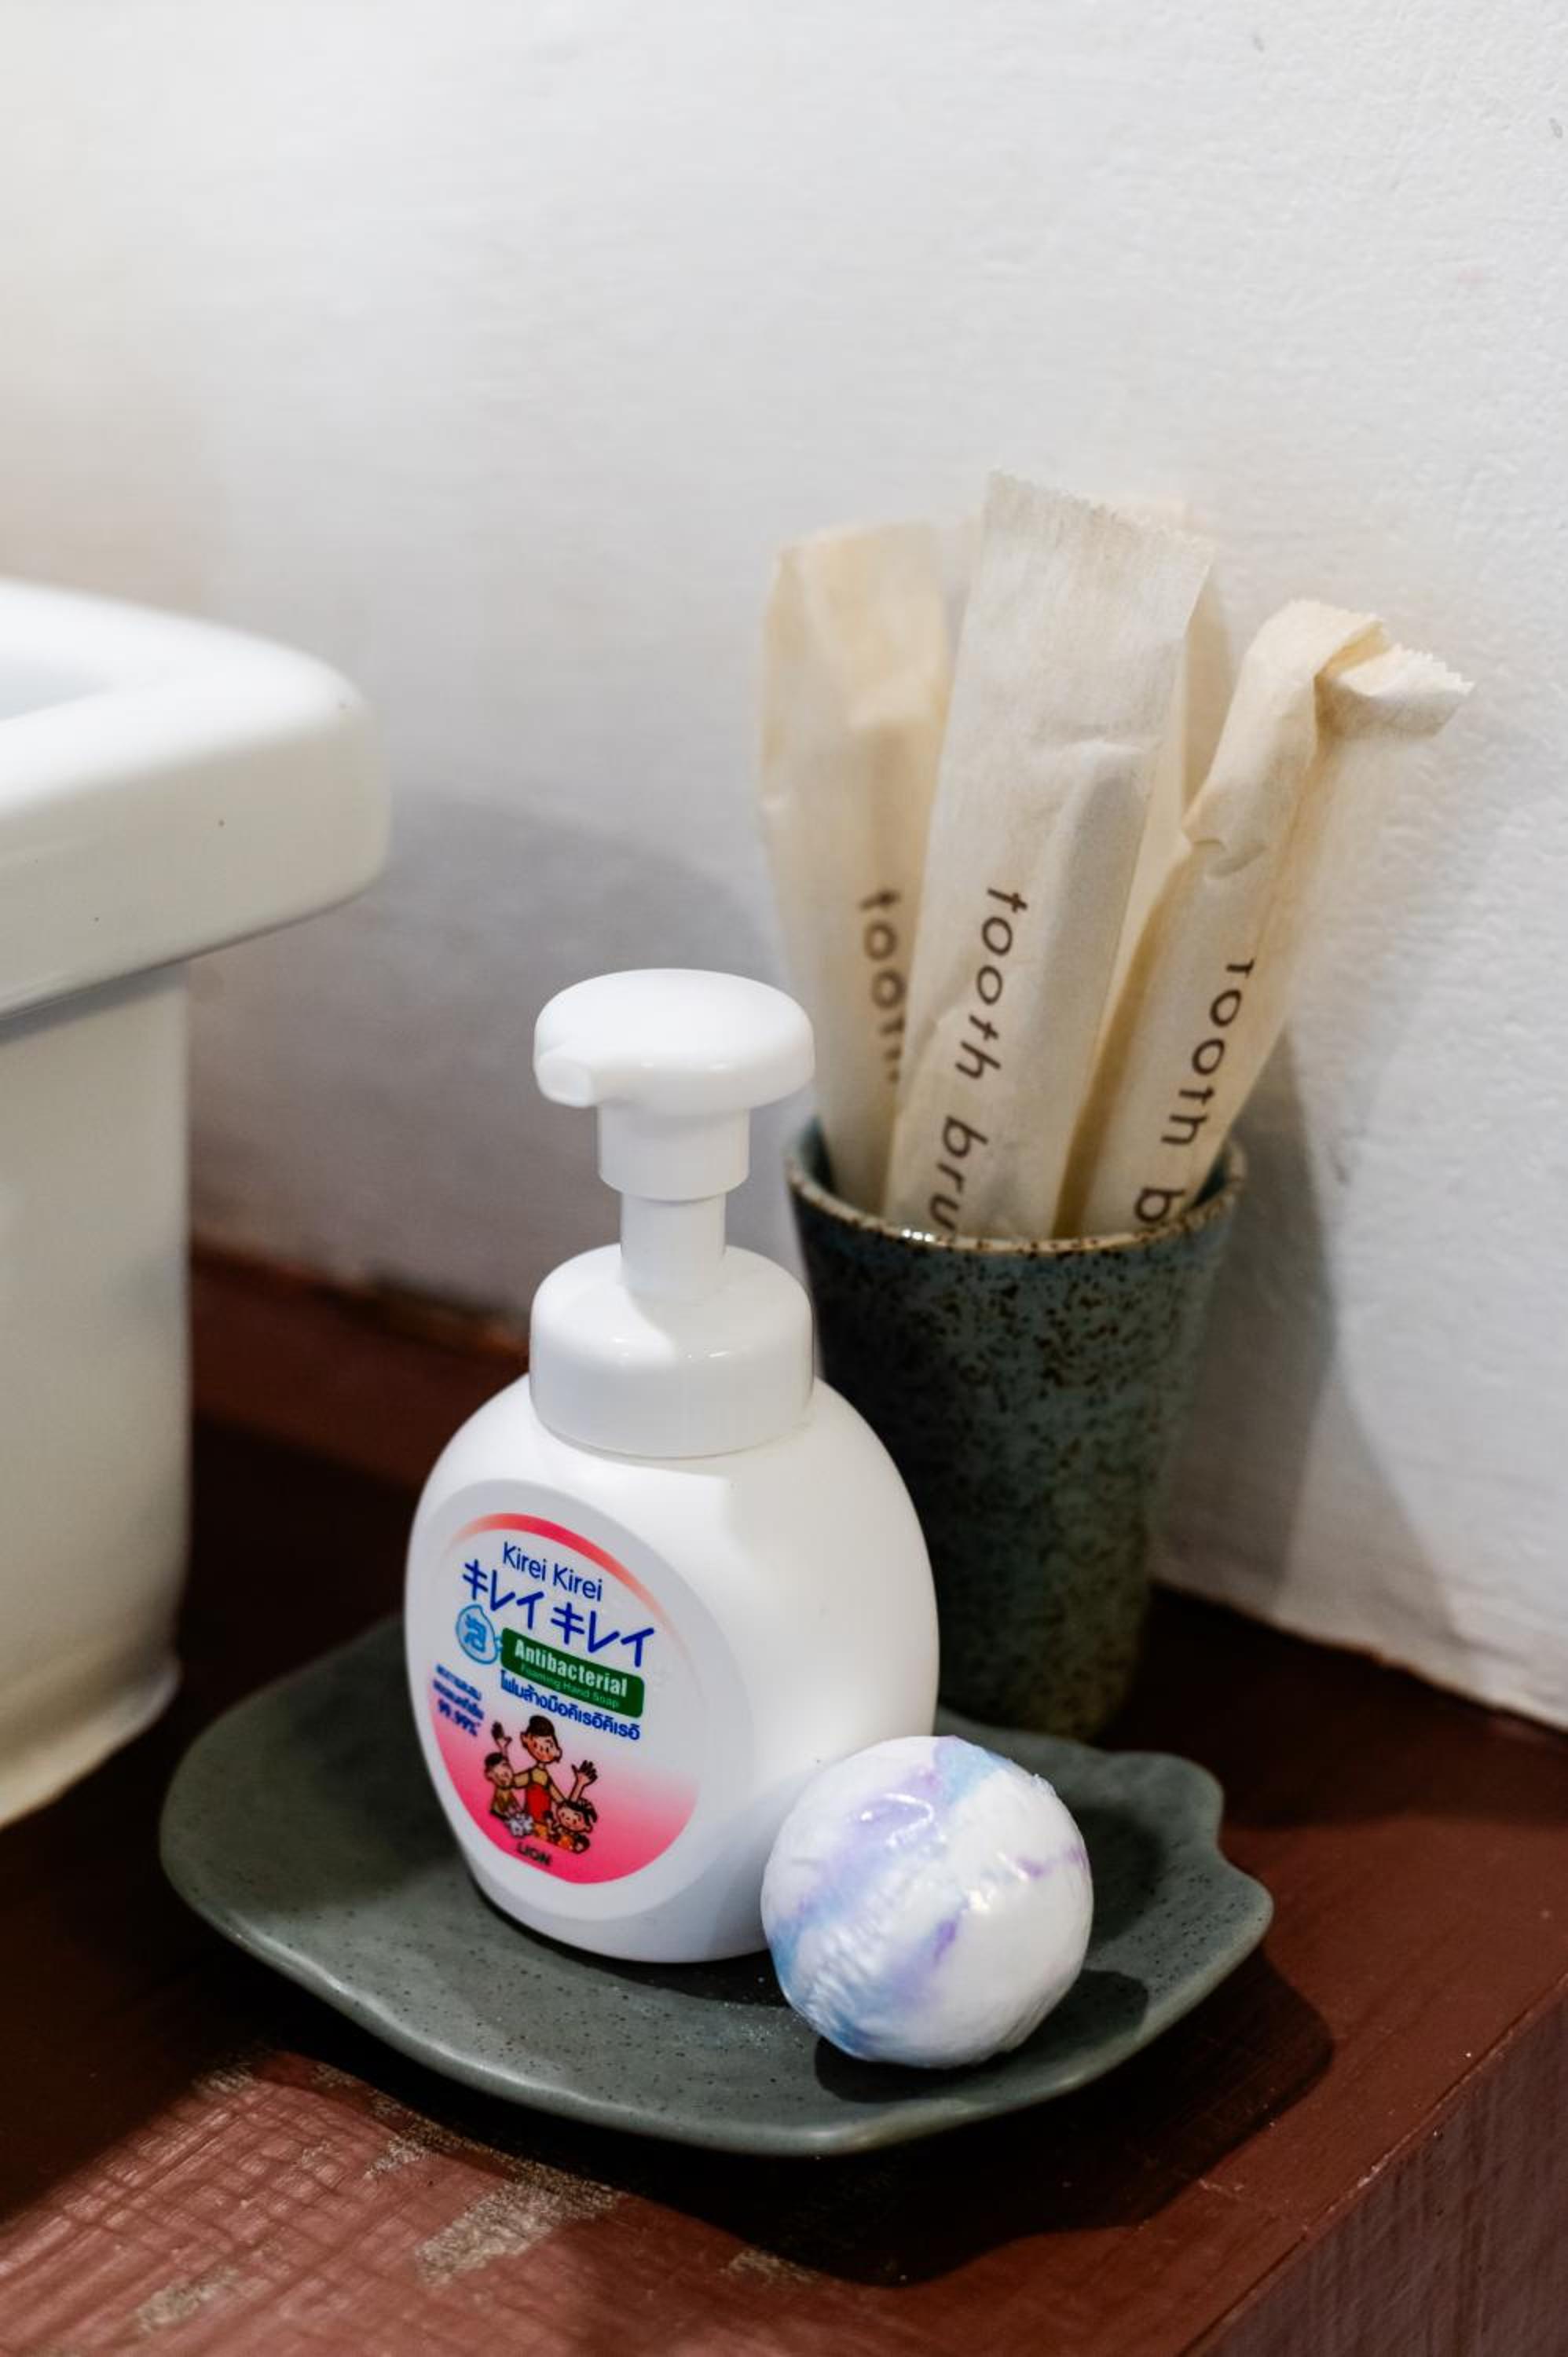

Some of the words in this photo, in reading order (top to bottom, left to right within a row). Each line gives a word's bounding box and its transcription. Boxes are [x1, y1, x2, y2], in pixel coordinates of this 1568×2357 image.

[954, 887, 1028, 1080] tooth
[502, 1541, 547, 1582] Kirei
[552, 1563, 603, 1602] Kirei
[462, 1558, 545, 1630] キレイ
[551, 1601, 655, 1668] キレイ
[515, 1638, 628, 1698] Antibacterial
[515, 1842, 552, 1867] LION
